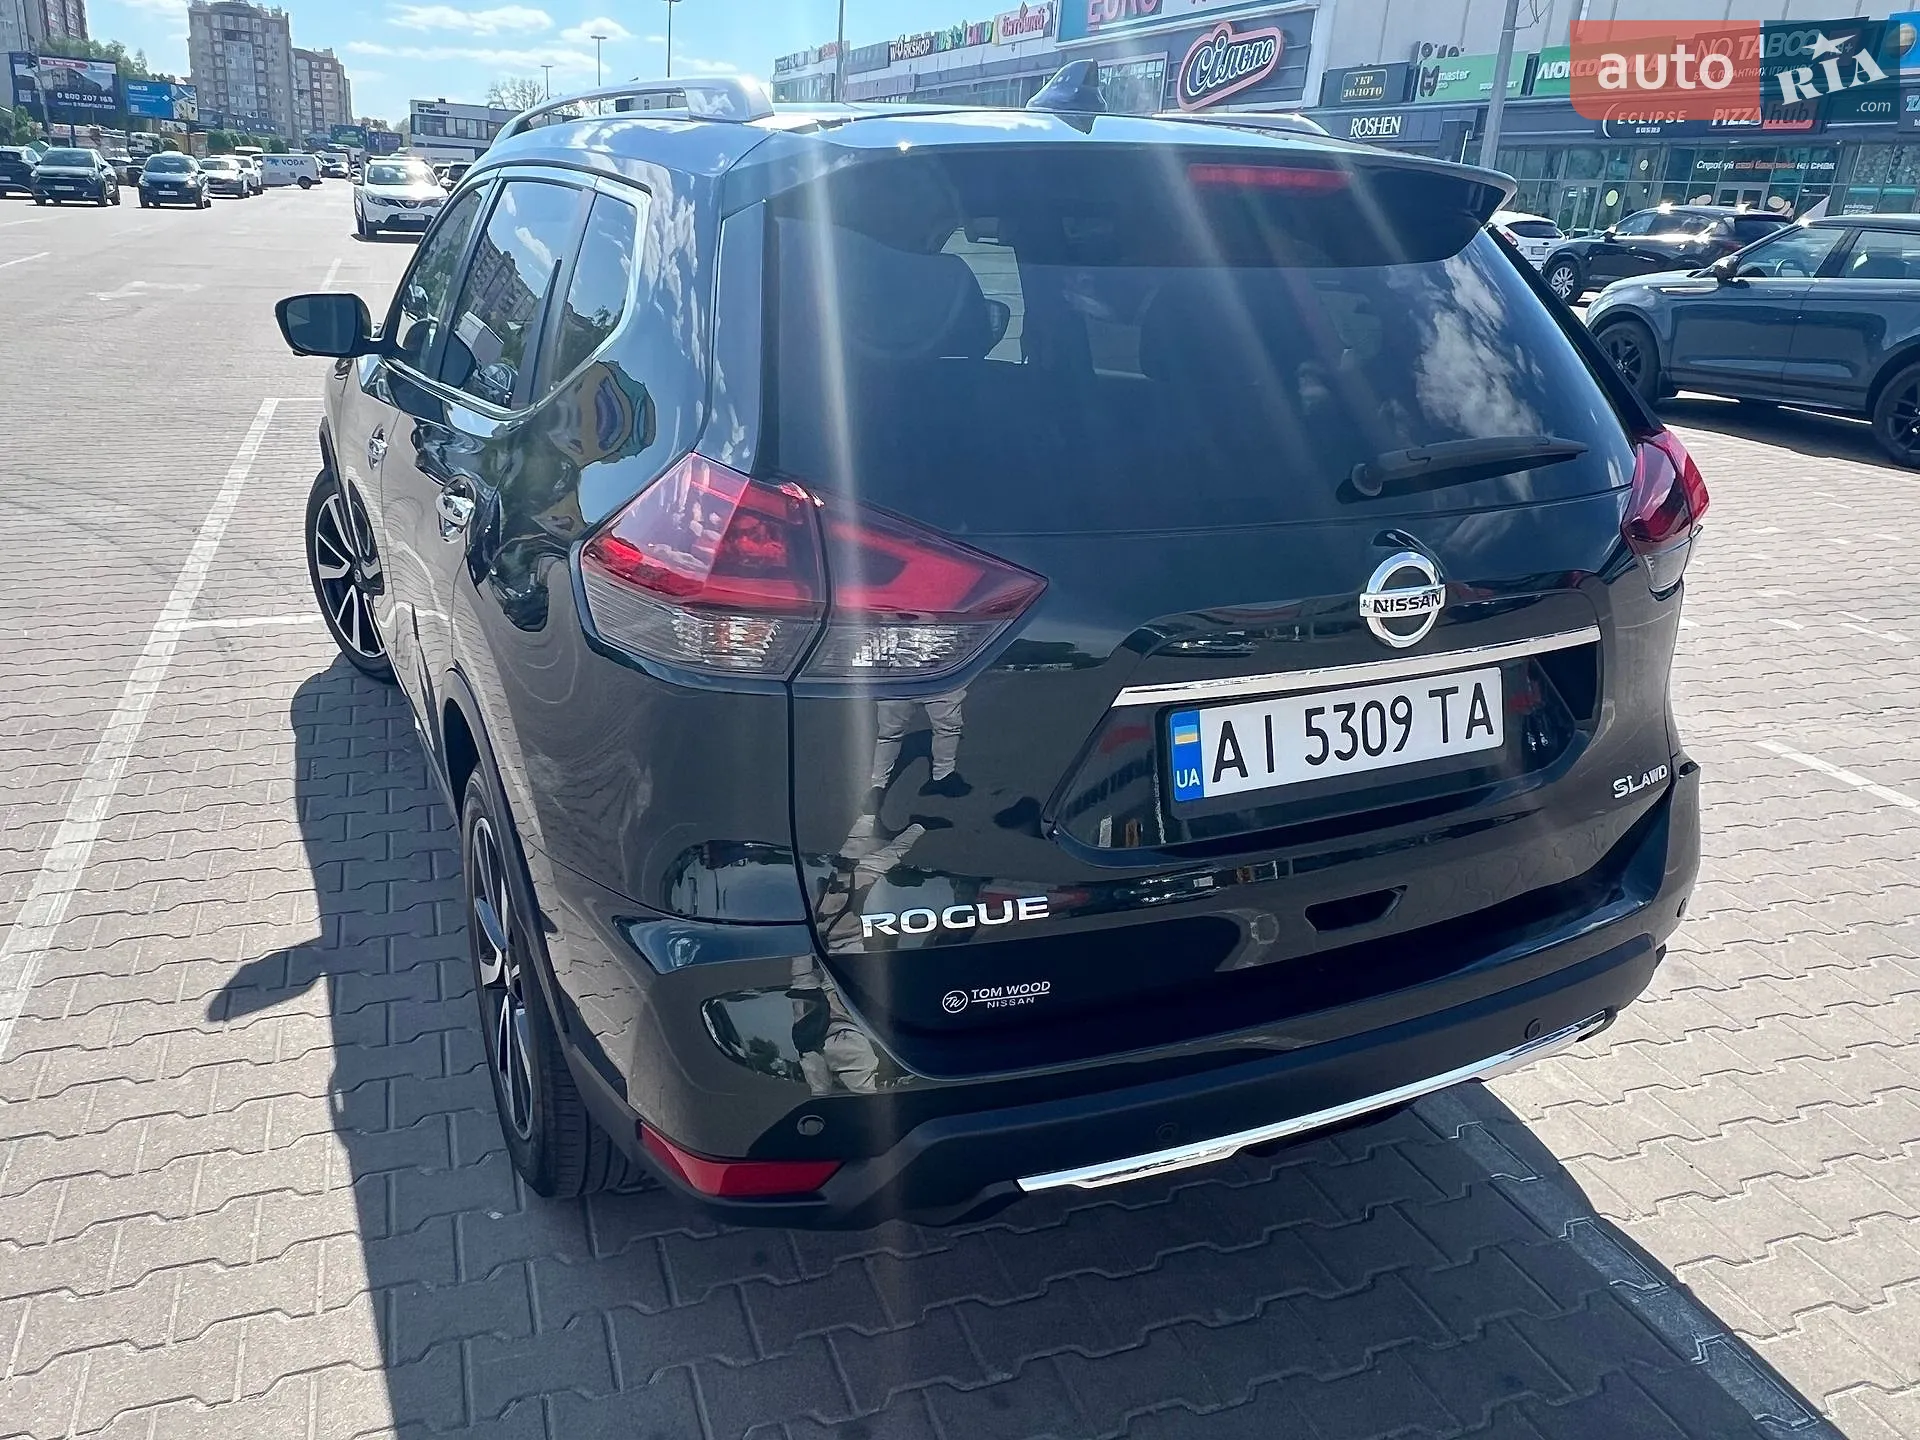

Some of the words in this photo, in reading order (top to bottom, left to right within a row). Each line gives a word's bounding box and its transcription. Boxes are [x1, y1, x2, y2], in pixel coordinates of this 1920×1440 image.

[1187, 35, 1275, 96] Сільпо
[1536, 53, 1661, 80] ЛЮКСОИА
[1717, 66, 1768, 79] ПАНТНИХ
[1343, 87, 1383, 98] ЗОЛОТО
[1617, 110, 1688, 125] ECLIPSE
[1711, 107, 1762, 126] PIZZA
[1768, 102, 1809, 124] hub
[1350, 116, 1402, 137] ROSHEN
[1372, 592, 1442, 615] NISSAN
[1212, 714, 1276, 784] AI
[1304, 694, 1413, 767] 5309
[1428, 682, 1495, 745] TA
[1176, 769, 1200, 789] UA
[859, 896, 1050, 938] ROGUE
[971, 986, 1002, 999] TOM
[1006, 981, 1051, 996] WOOD
[987, 997, 1035, 1009] NISSAN
